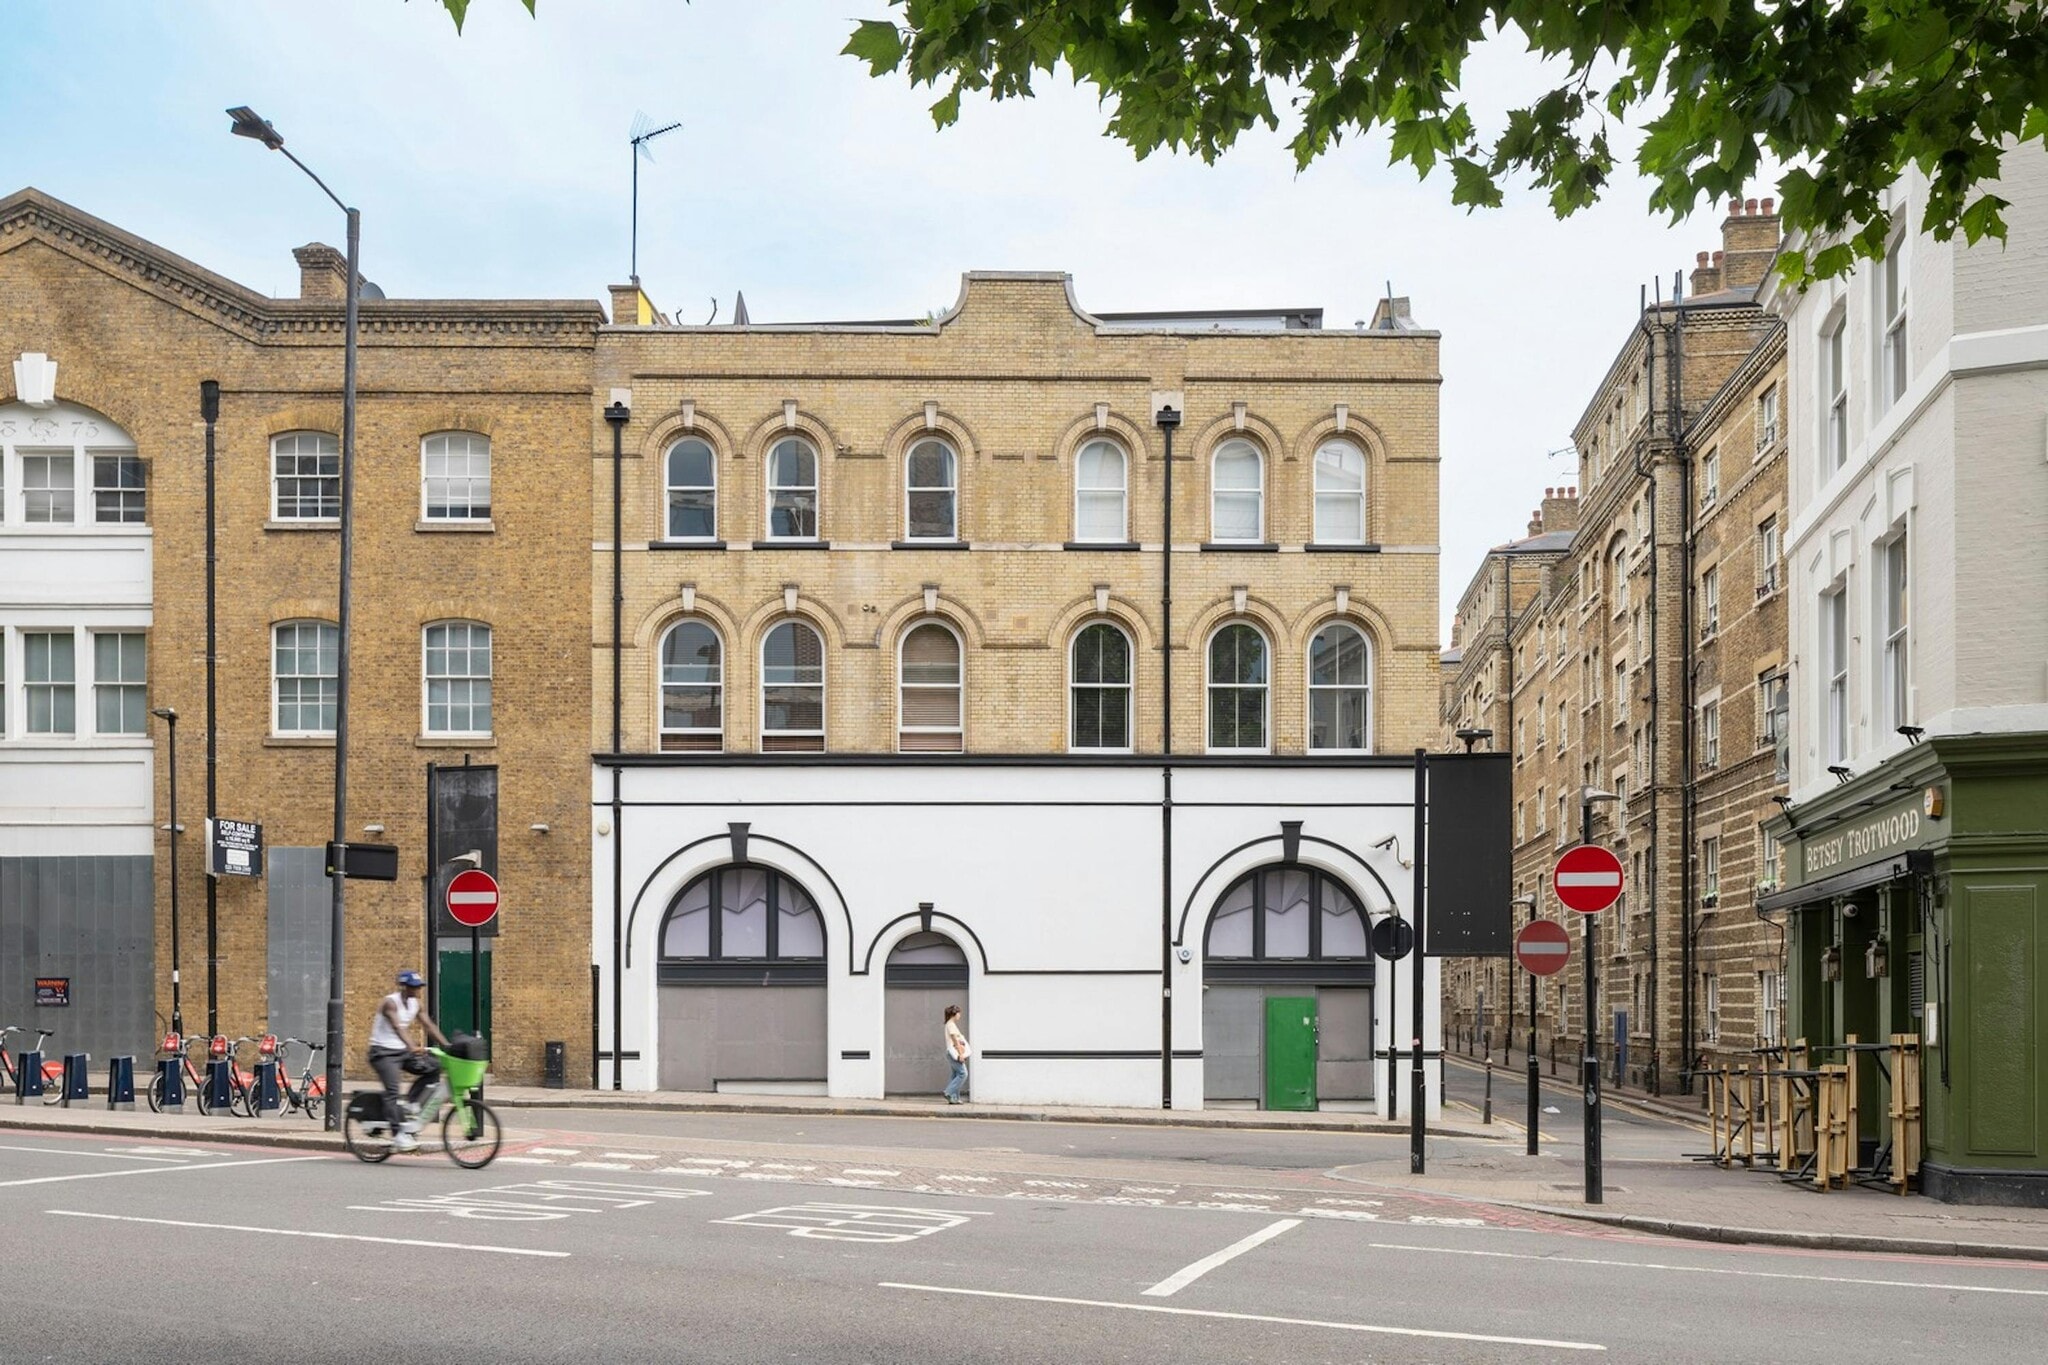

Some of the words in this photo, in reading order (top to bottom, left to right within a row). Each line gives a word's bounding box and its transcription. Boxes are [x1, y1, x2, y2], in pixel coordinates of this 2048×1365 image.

[220, 821, 235, 830] FOR
[236, 823, 256, 833] SALE
[1807, 836, 1844, 872] BETSEY
[1847, 809, 1919, 858] TROTWOOD
[346, 1180, 713, 1221] CLEAR
[708, 1202, 994, 1242] KEEP
